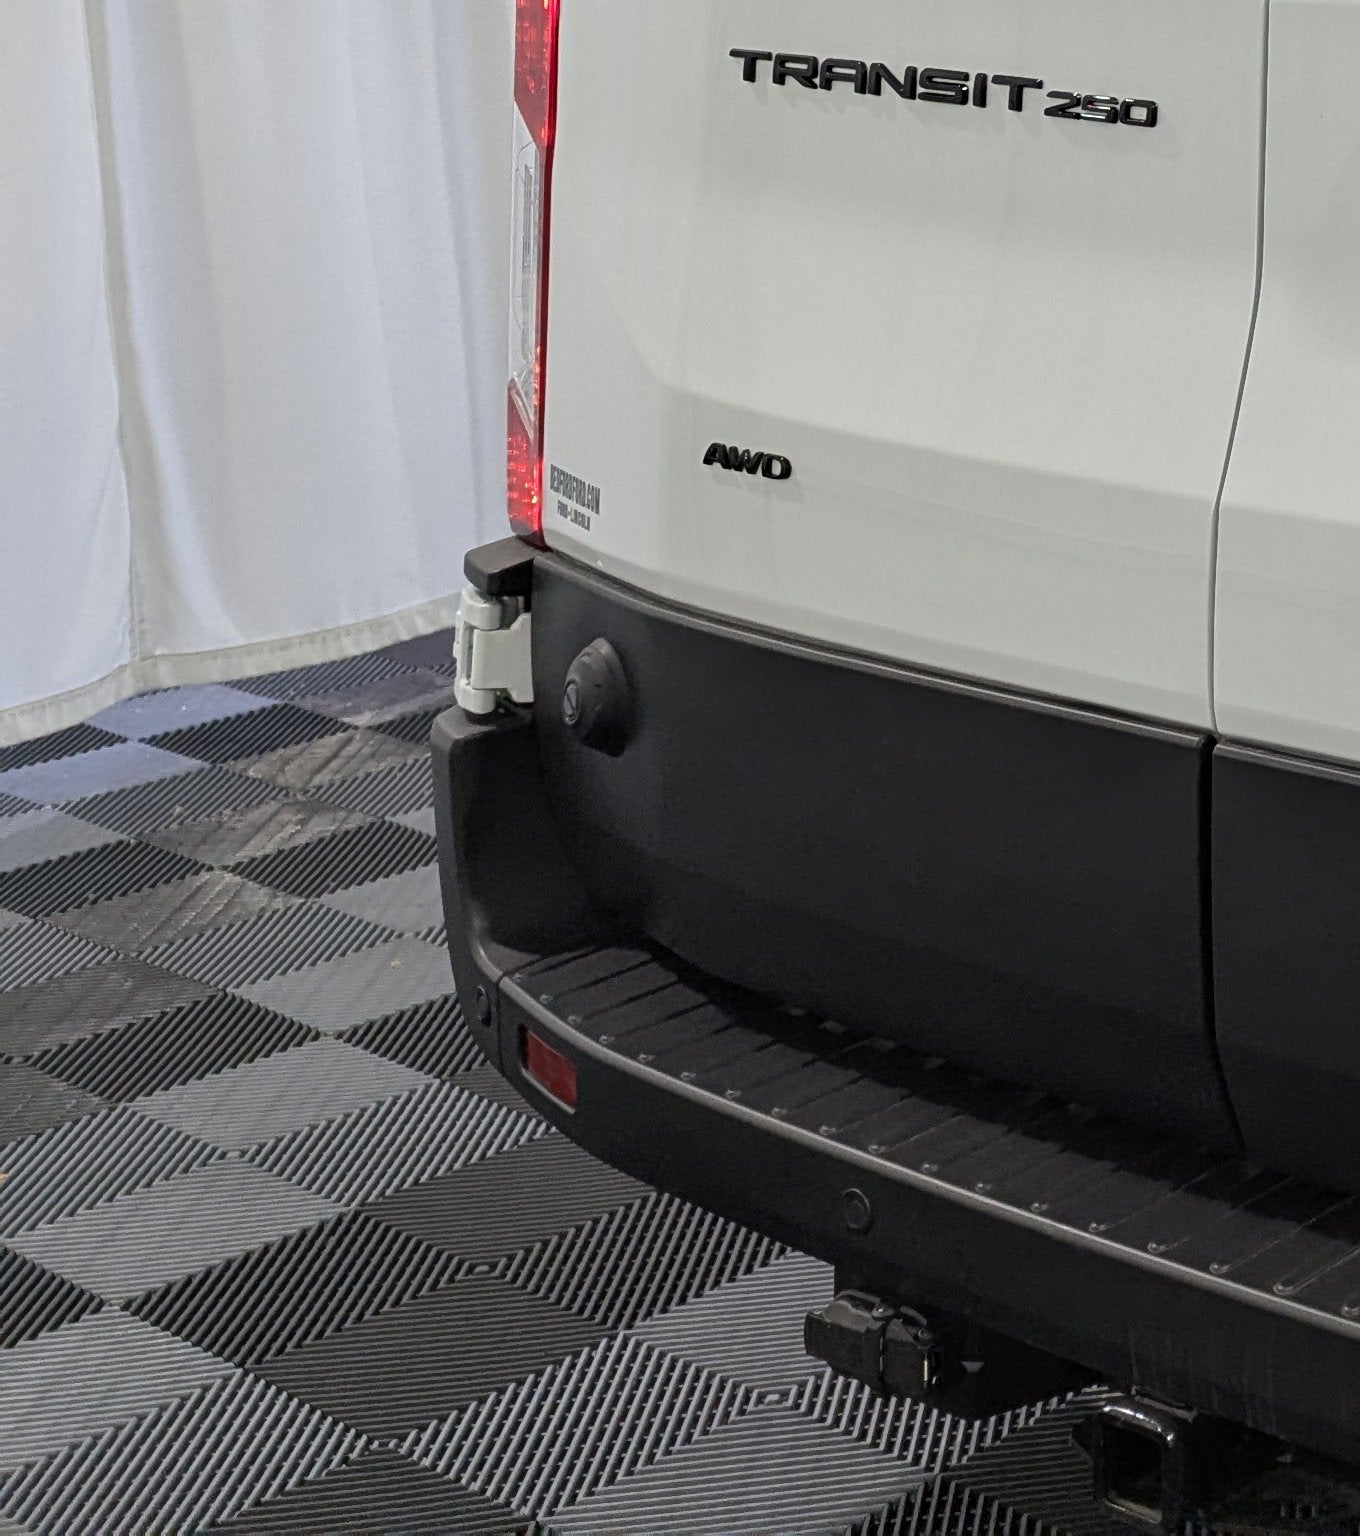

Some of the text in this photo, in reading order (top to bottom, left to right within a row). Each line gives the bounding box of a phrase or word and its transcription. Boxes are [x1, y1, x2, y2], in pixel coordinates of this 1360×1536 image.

[729, 48, 1158, 128] TRANSIT 250
[702, 442, 792, 480] AWD
